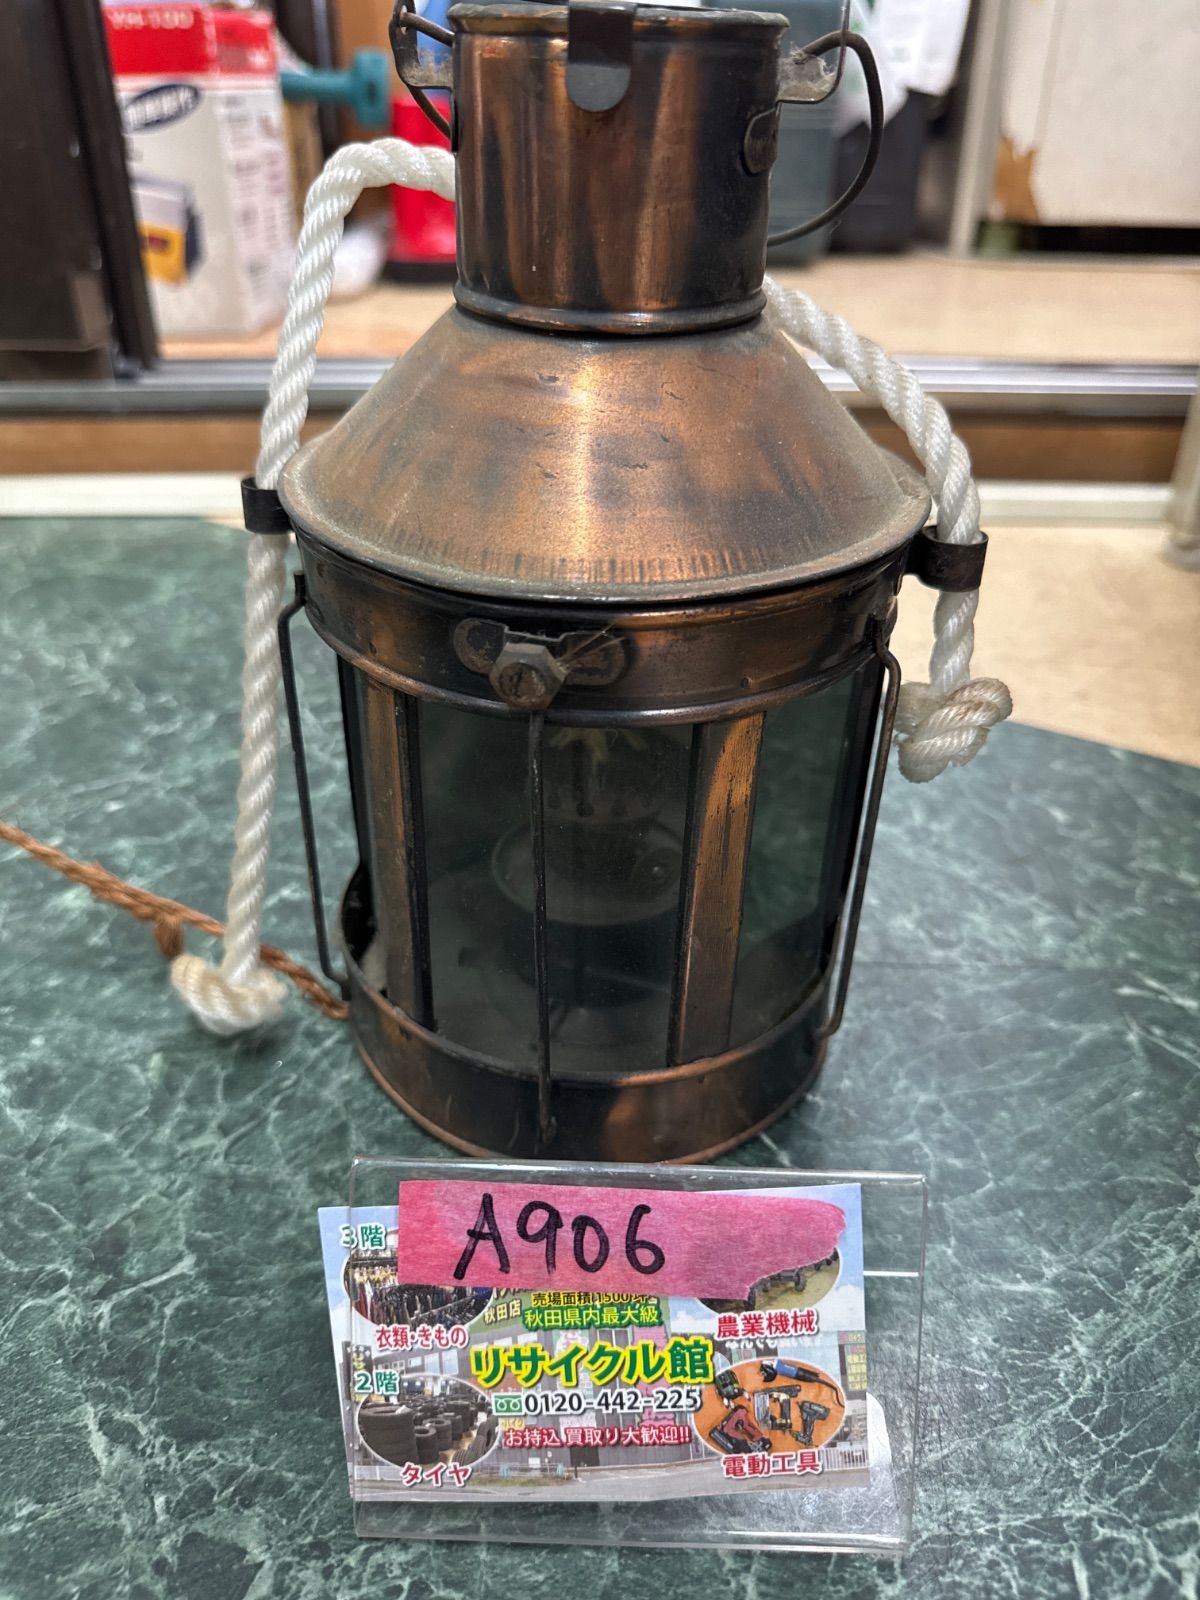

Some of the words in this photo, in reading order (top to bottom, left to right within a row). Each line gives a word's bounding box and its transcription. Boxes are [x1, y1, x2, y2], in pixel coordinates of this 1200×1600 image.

[341, 1224, 385, 1248] 3階
[453, 1192, 666, 1280] A906
[484, 1299, 522, 1325] 秋田店
[524, 1305, 660, 1328] 秋田県内最大級
[716, 1309, 817, 1339] 農業機械
[471, 1338, 712, 1386] リサイクル館
[355, 1371, 399, 1393] 2階
[524, 1387, 701, 1413] 0120-442-225
[505, 1427, 561, 1447] お持込
[401, 1462, 472, 1486] タイヤ
[722, 1450, 821, 1477] 電動工具
